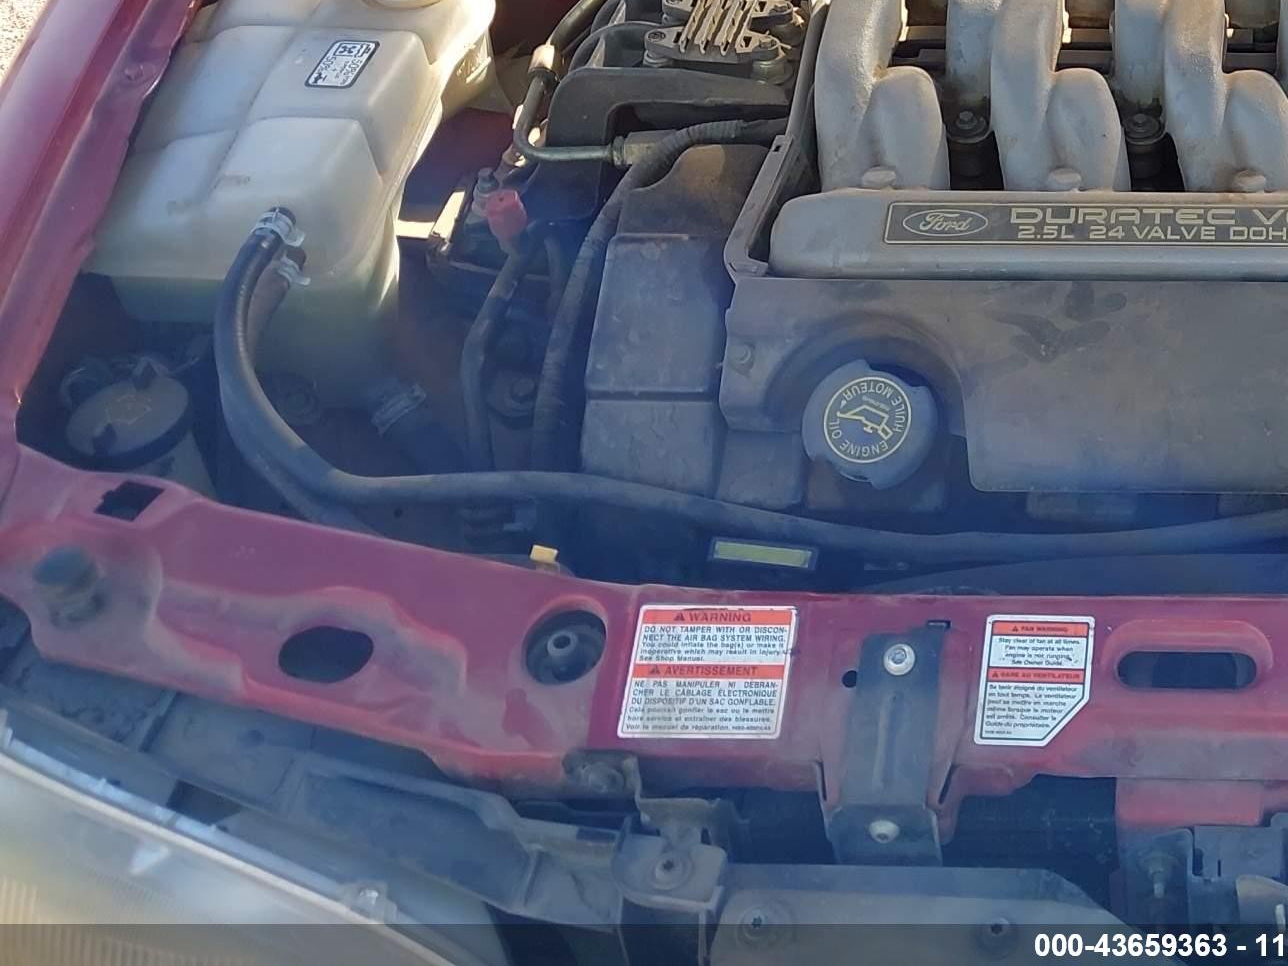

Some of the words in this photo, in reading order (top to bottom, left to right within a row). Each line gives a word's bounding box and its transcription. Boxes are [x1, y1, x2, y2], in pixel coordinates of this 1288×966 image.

[920, 211, 971, 232] Ford
[1010, 208, 1239, 225] DURATEC
[1017, 226, 1072, 239] 2.5L
[1089, 226, 1125, 240] 24
[1131, 226, 1216, 240] VALVE
[842, 382, 894, 400] MOTEUR
[891, 396, 905, 432] HUILE
[829, 418, 842, 439] OIL
[840, 440, 889, 457] ENGINE
[689, 613, 751, 622] WARNING
[665, 666, 758, 675] AVERTISSEMENT
[728, 698, 776, 706] GONFLABLE.
